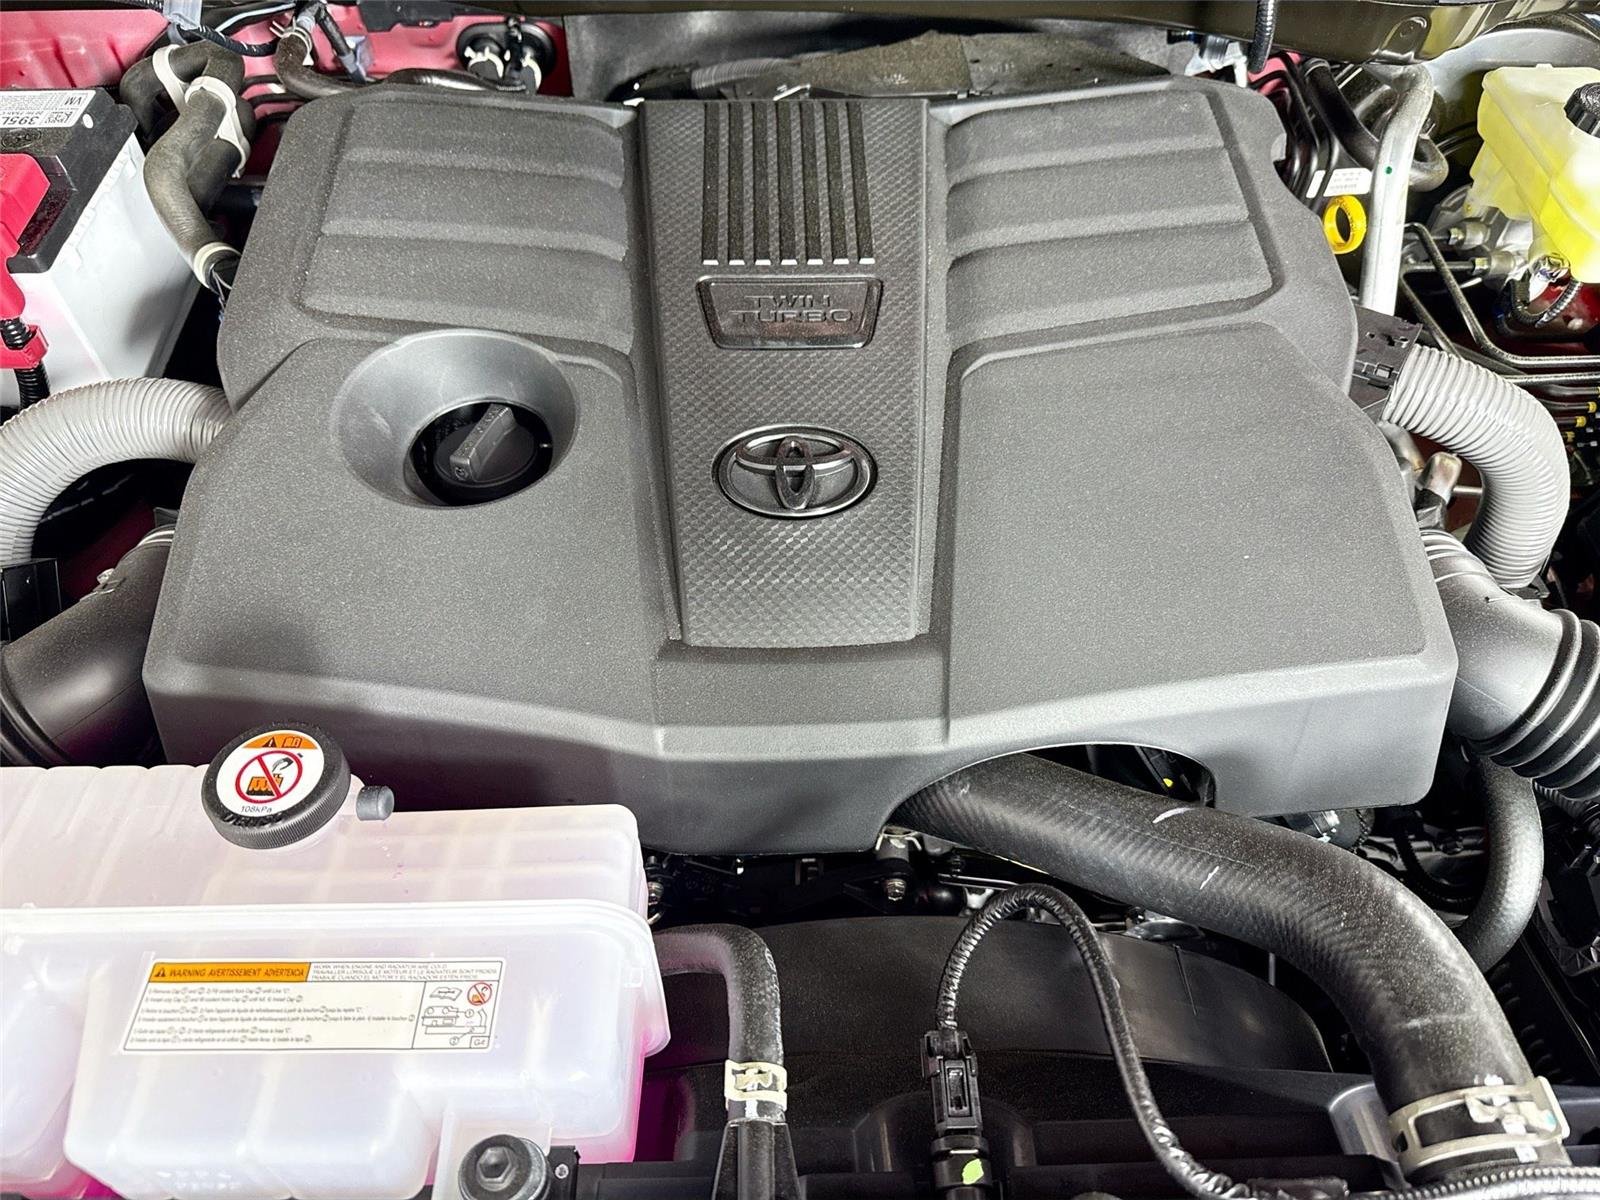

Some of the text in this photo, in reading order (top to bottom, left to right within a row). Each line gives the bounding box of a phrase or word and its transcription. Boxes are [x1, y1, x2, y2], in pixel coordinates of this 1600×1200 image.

[744, 294, 831, 308] TWIN
[728, 308, 853, 323] TURBO
[240, 805, 273, 813] 108kPa
[169, 968, 206, 977] WARNING
[208, 968, 261, 977] AVERTISSEMENT
